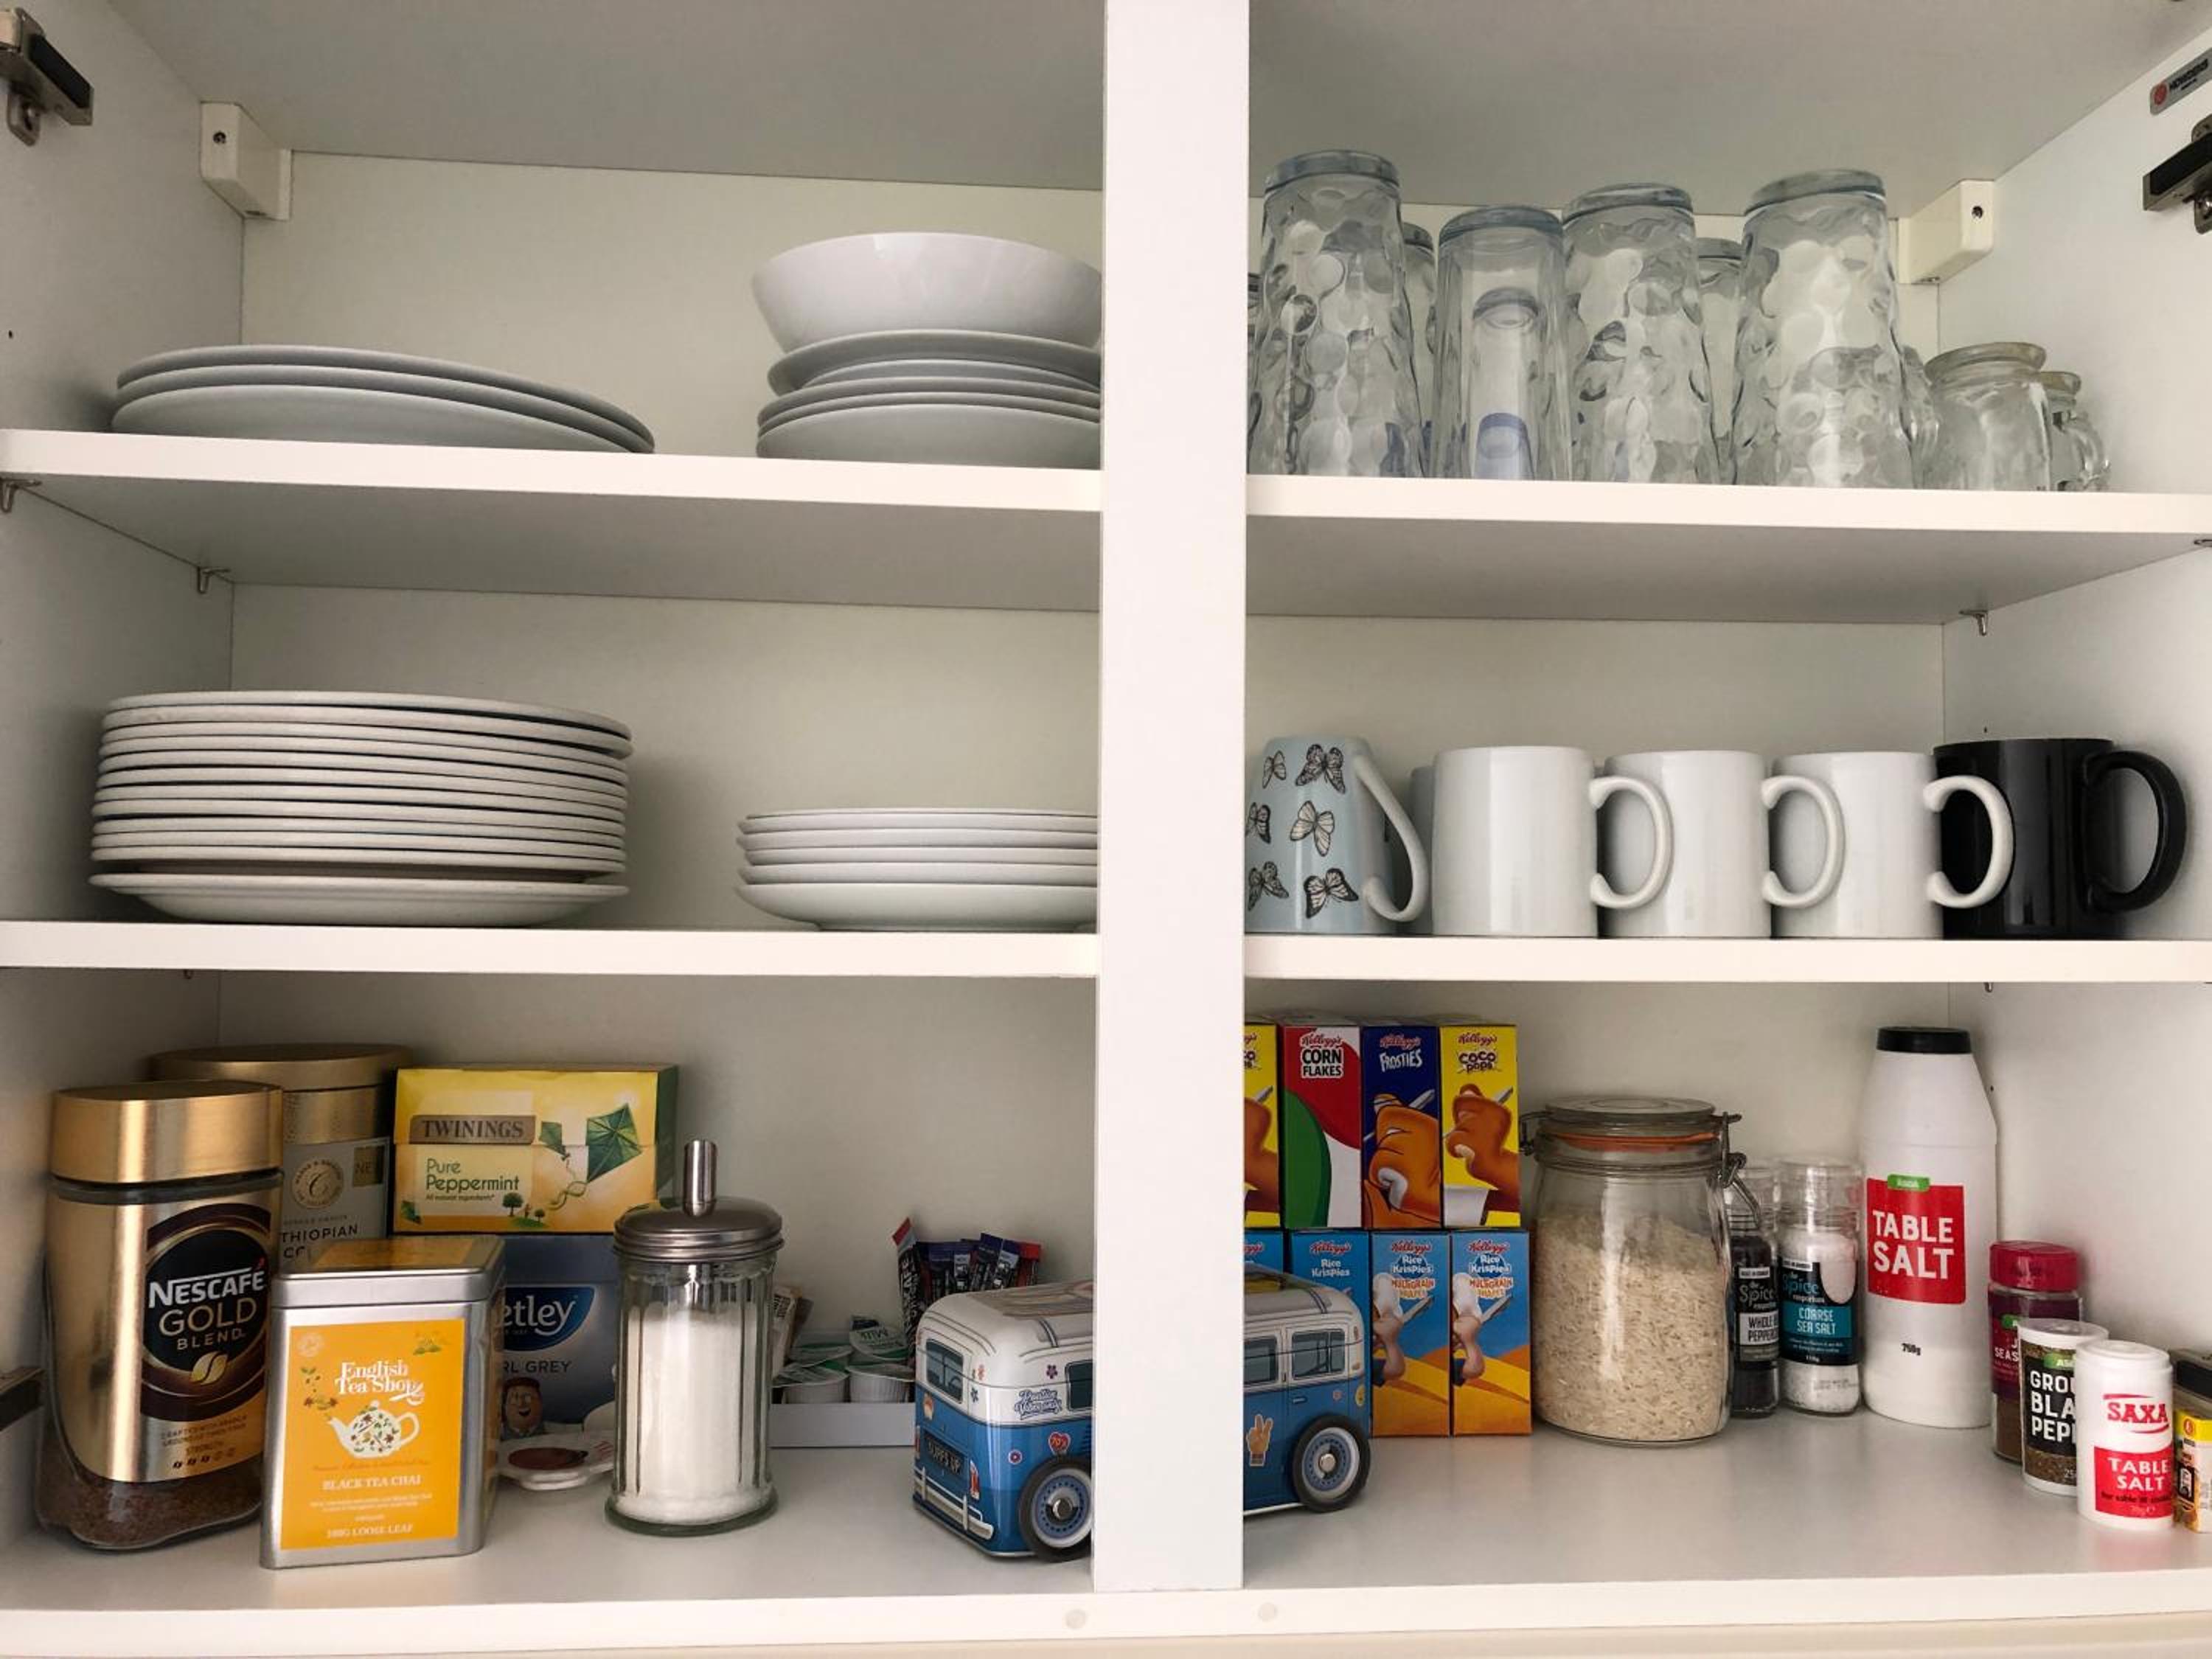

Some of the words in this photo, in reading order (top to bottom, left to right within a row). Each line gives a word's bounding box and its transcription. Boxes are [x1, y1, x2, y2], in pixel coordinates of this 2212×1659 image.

[1302, 1032, 1342, 1047] Kellogg's
[1380, 1034, 1422, 1049] Kellogg's
[1458, 1033, 1498, 1046] Kellogg's
[1302, 1049, 1341, 1063] CORN
[1379, 1049, 1423, 1073] FROSTIES
[1458, 1051, 1496, 1064] COCO
[1303, 1065, 1340, 1077] FLAKES
[423, 1120, 524, 1138] TWININGS
[427, 1158, 461, 1173] Pure
[426, 1175, 520, 1193] Peppermint
[282, 1224, 358, 1243] THIOPIAN
[1872, 1209, 1954, 1243] TABLE
[1310, 1241, 1351, 1256] Kellogg's
[1391, 1240, 1432, 1255] Kellogg's
[1468, 1239, 1509, 1253] Kellogg's
[1321, 1259, 1342, 1267] Rice
[1402, 1254, 1422, 1264] Rice
[1480, 1254, 1500, 1264] Rice
[1874, 1241, 1954, 1279] SALT
[1312, 1267, 1350, 1277] Krispies
[1392, 1264, 1432, 1274] Krispies
[1470, 1264, 1509, 1274] Krispies
[159, 1298, 257, 1336] GOLD
[504, 1295, 576, 1336] etley
[1798, 1307, 1834, 1322] COARSE
[1797, 1319, 1813, 1333] SEA
[1815, 1322, 1837, 1335] SALT
[177, 1329, 243, 1350] BLEND
[1902, 1342, 1921, 1357] 750g
[1994, 1346, 2019, 1362] SEAS
[338, 1359, 408, 1381] English
[525, 1360, 571, 1373] GREY
[335, 1376, 367, 1394] Tea
[2031, 1392, 2076, 1419] BLA
[2107, 1402, 2168, 1424] SAXA
[2107, 1456, 2171, 1475] TABLE
[322, 1478, 361, 1491] BLACK
[367, 1476, 389, 1488] TEA
[392, 1474, 422, 1486] CHAI
[2118, 1475, 2165, 1492] SALT
[388, 1523, 414, 1534] LEAF
